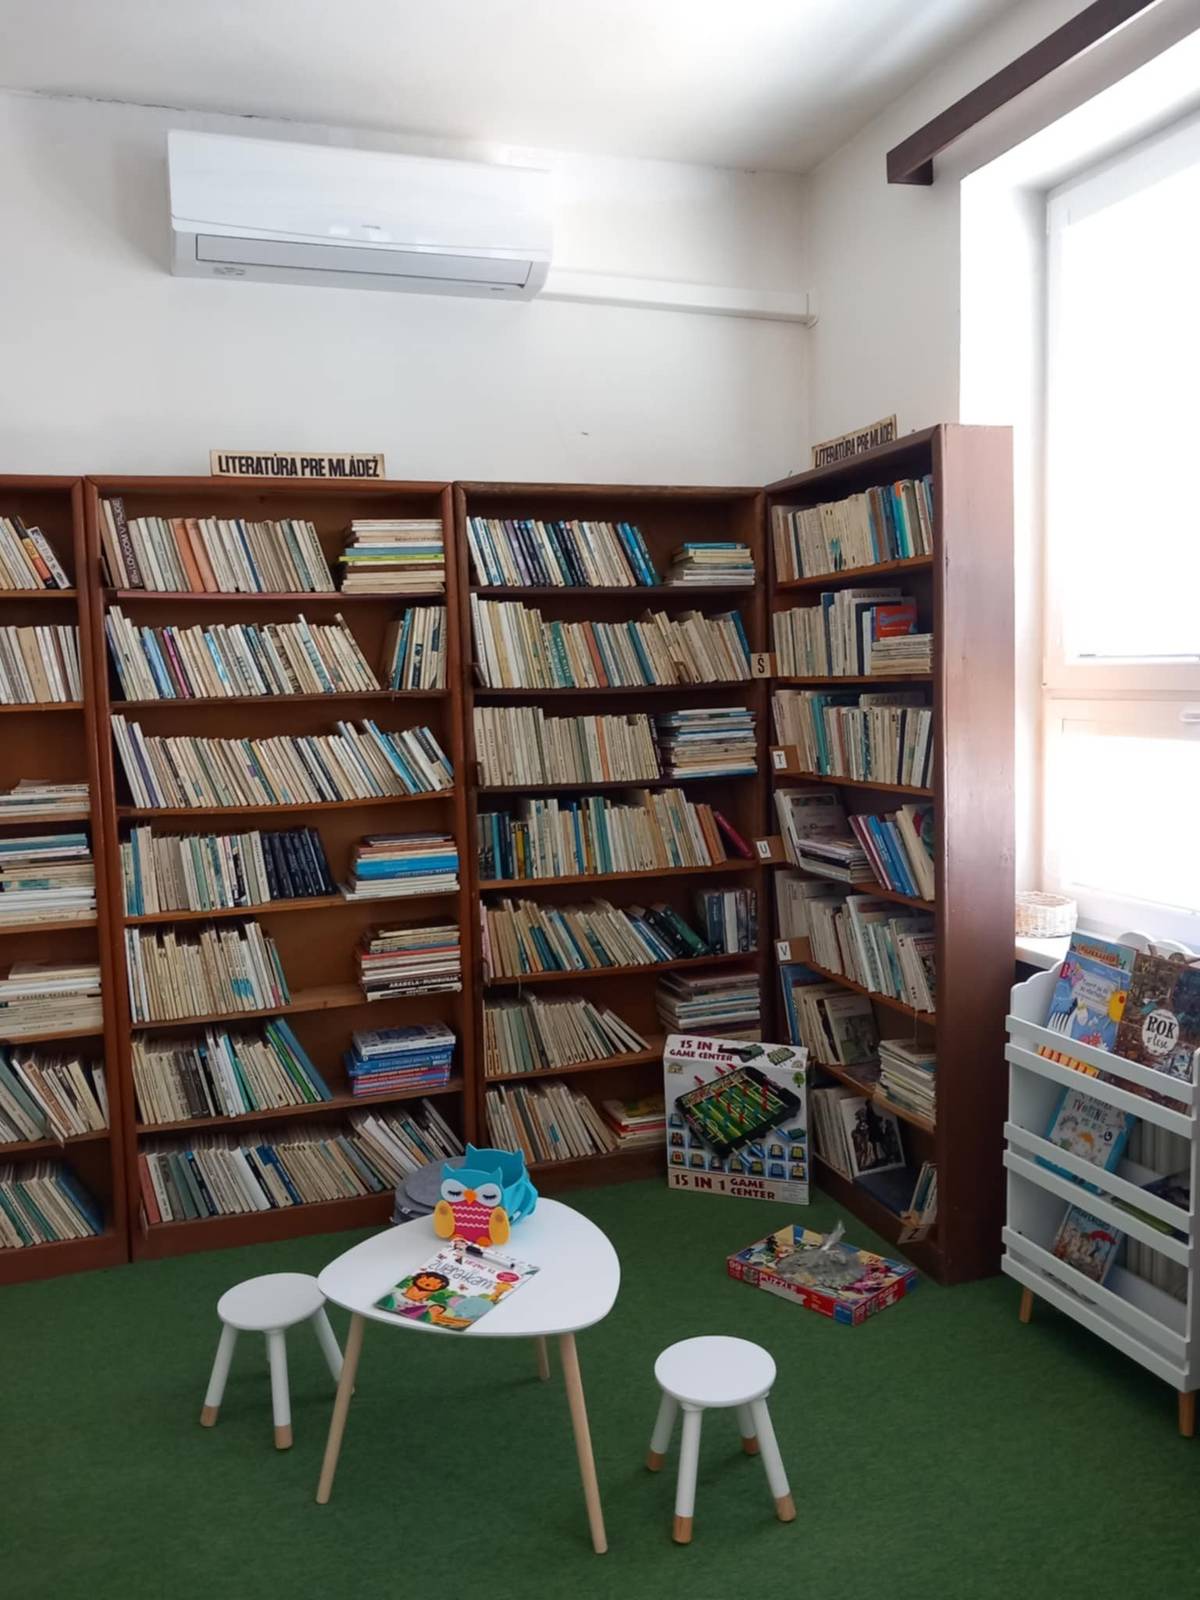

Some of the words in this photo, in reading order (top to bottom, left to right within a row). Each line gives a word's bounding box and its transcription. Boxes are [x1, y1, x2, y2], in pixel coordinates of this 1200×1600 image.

[218, 453, 298, 476] LITERATÚRA
[301, 457, 326, 477] PRE
[328, 455, 379, 478] MLÁDEŽ
[757, 654, 765, 673] Š
[776, 753, 783, 764] T
[760, 843, 768, 854] U
[780, 945, 788, 955] V
[1147, 1016, 1176, 1039] ROK
[681, 1040, 692, 1048] 15
[697, 1041, 712, 1051] IN
[669, 1049, 695, 1058] GAME
[698, 1052, 733, 1062] CENTER
[674, 1174, 688, 1186] 15
[694, 1176, 712, 1189] IN
[719, 1180, 725, 1191] 1
[730, 1178, 765, 1189] GAME
[730, 1187, 776, 1200] CENTER
